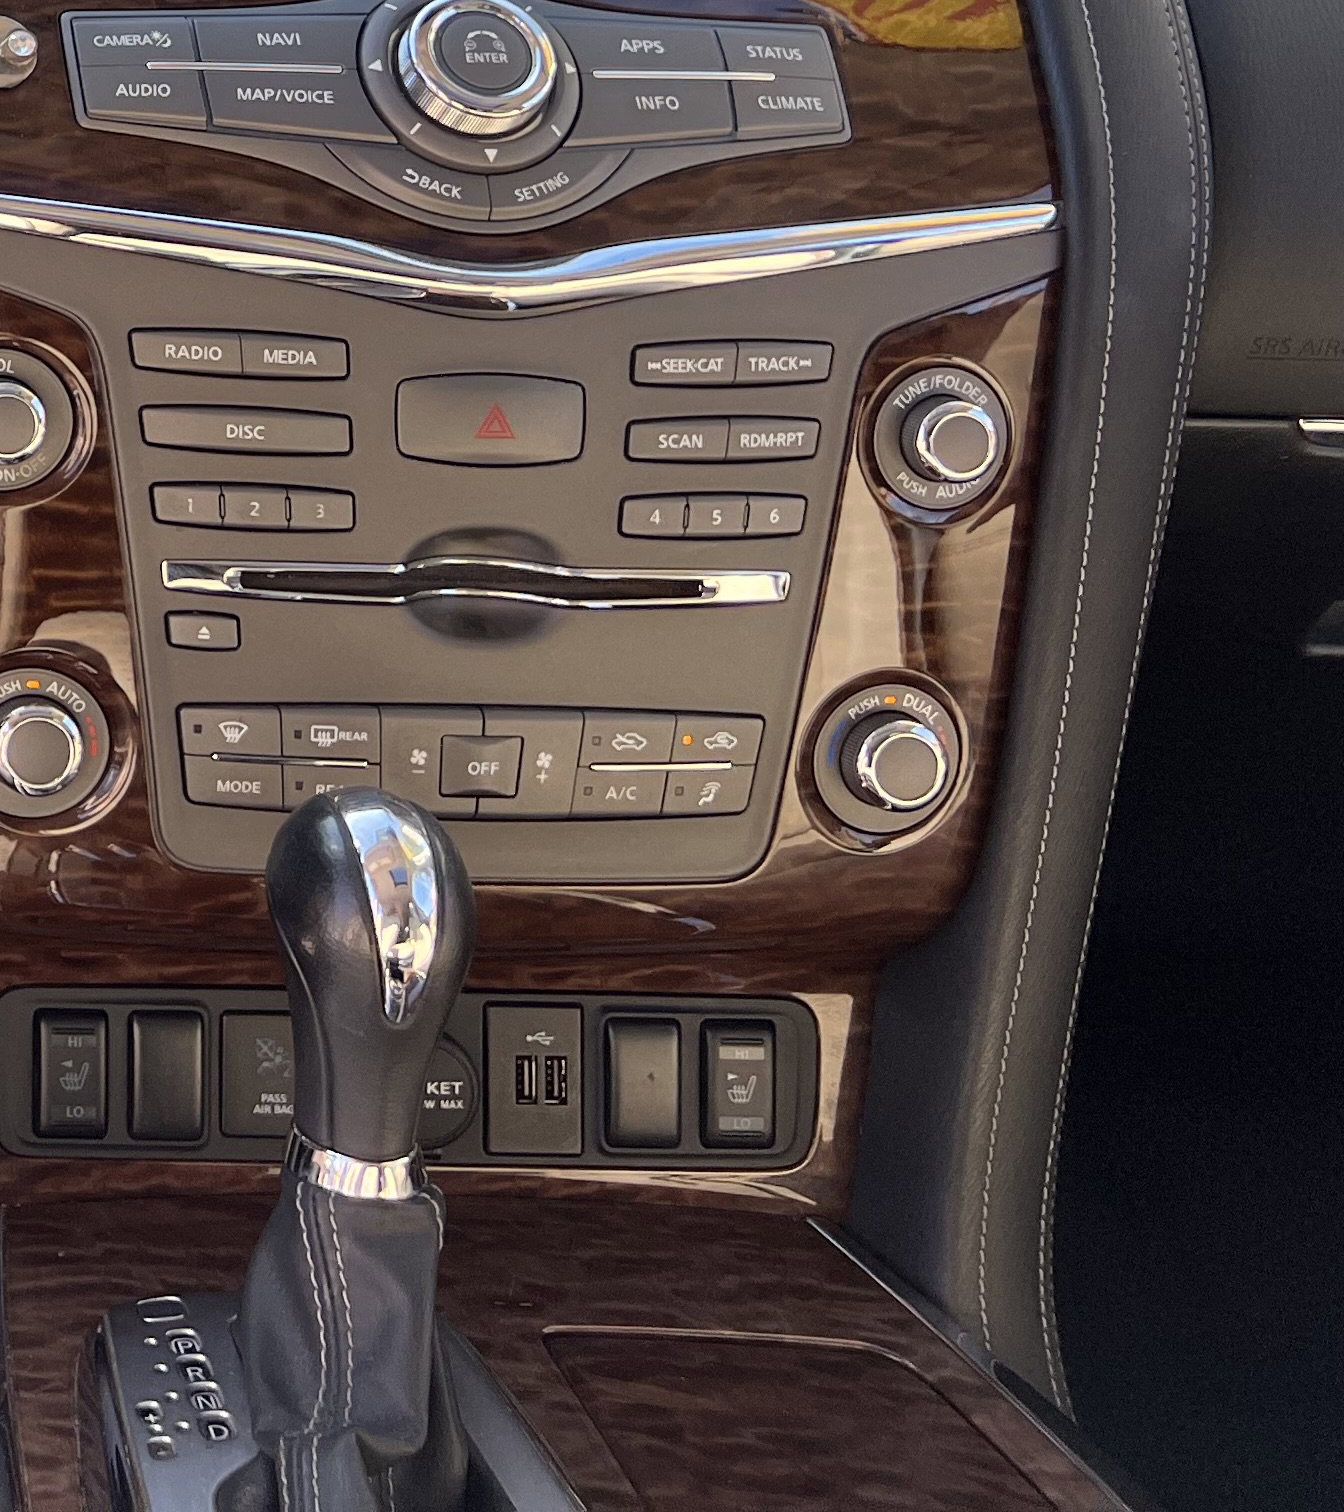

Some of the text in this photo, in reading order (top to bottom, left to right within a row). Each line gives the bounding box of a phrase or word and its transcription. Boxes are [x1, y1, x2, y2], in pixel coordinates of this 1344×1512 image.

[93, 33, 152, 49] CAMERA
[257, 32, 302, 47] NAVI
[620, 39, 665, 56] APPS
[465, 50, 510, 66] ENTER
[746, 43, 803, 62] STATUS
[115, 82, 171, 99] AUDIO
[236, 87, 335, 106] MAP/VOICE
[635, 94, 680, 112] INFO
[757, 94, 825, 112] CLIMATE
[417, 173, 463, 200] BACK
[513, 170, 571, 203] SETTING
[164, 343, 223, 362] RADIO
[263, 348, 318, 367] MEDIA
[748, 356, 799, 373] TRACK
[893, 374, 989, 410] TUNE/FOLDER
[225, 423, 266, 440] DISC
[658, 433, 703, 449] SCAN
[896, 471, 927, 497] PUSH
[186, 497, 194, 514] 1
[249, 501, 261, 518] 2
[315, 502, 325, 519] 3
[650, 509, 661, 525] 4
[712, 509, 722, 525] 5
[769, 508, 780, 524] 6
[46, 681, 86, 715] AUTO
[847, 693, 939, 725] PUSH DUAL
[338, 731, 368, 742] REAR
[467, 761, 500, 777] OFF
[216, 780, 261, 795] MODE
[605, 785, 638, 802] A/C
[67, 1036, 83, 1048] HI
[426, 1081, 464, 1095] KET
[261, 1093, 288, 1103] PASS
[66, 1105, 84, 1118] LO
[252, 1104, 272, 1114] AIR
[177, 1340, 193, 1354] P
[186, 1365, 206, 1382] R
[197, 1394, 216, 1410] N
[207, 1424, 229, 1441] D
